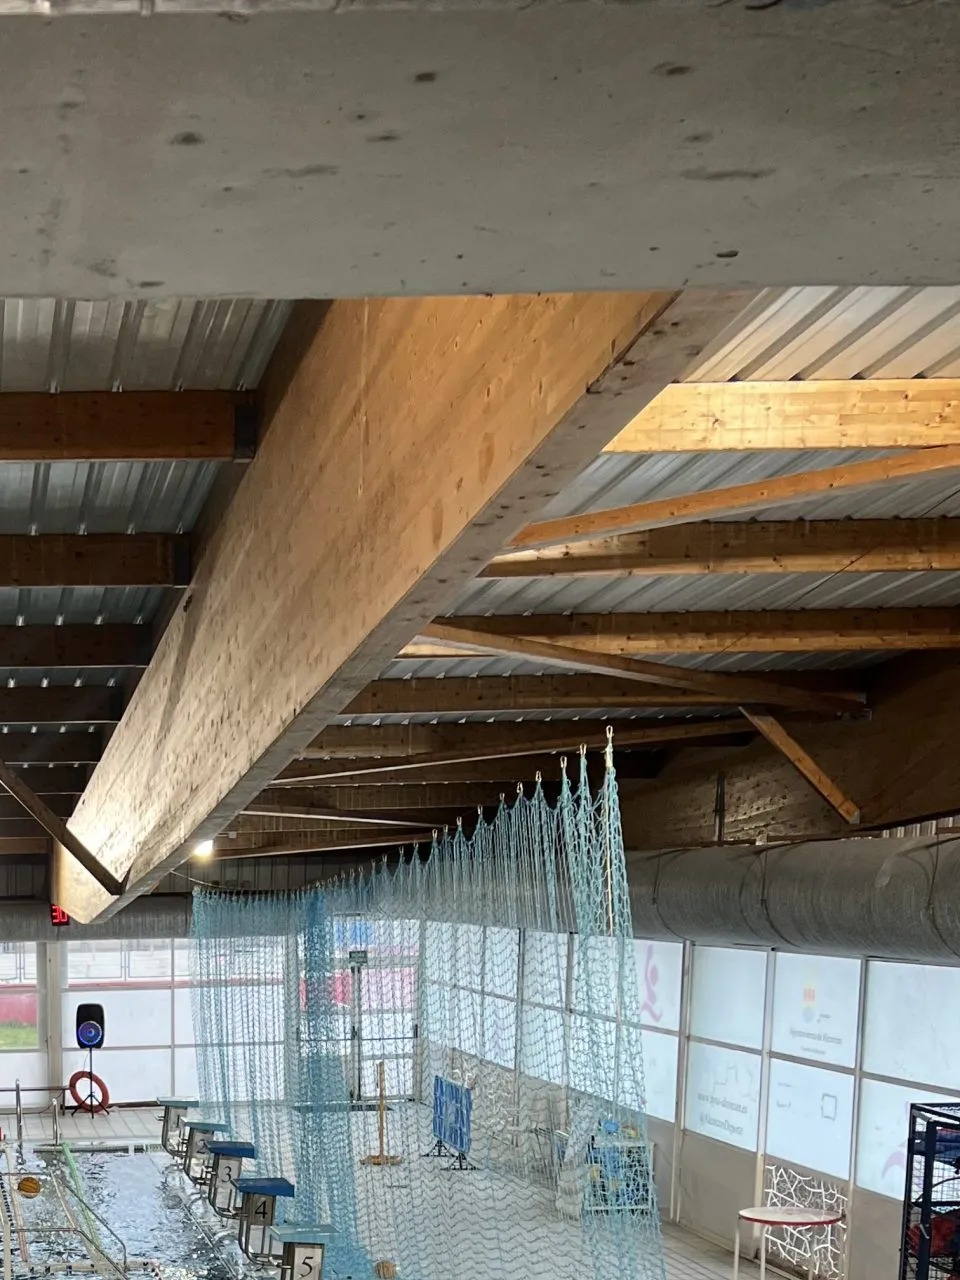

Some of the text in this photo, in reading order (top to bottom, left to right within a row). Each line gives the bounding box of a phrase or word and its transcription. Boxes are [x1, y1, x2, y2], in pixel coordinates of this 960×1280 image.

[221, 1166, 232, 1182] 3
[255, 1200, 268, 1219] 4
[300, 1256, 314, 1277] 5
